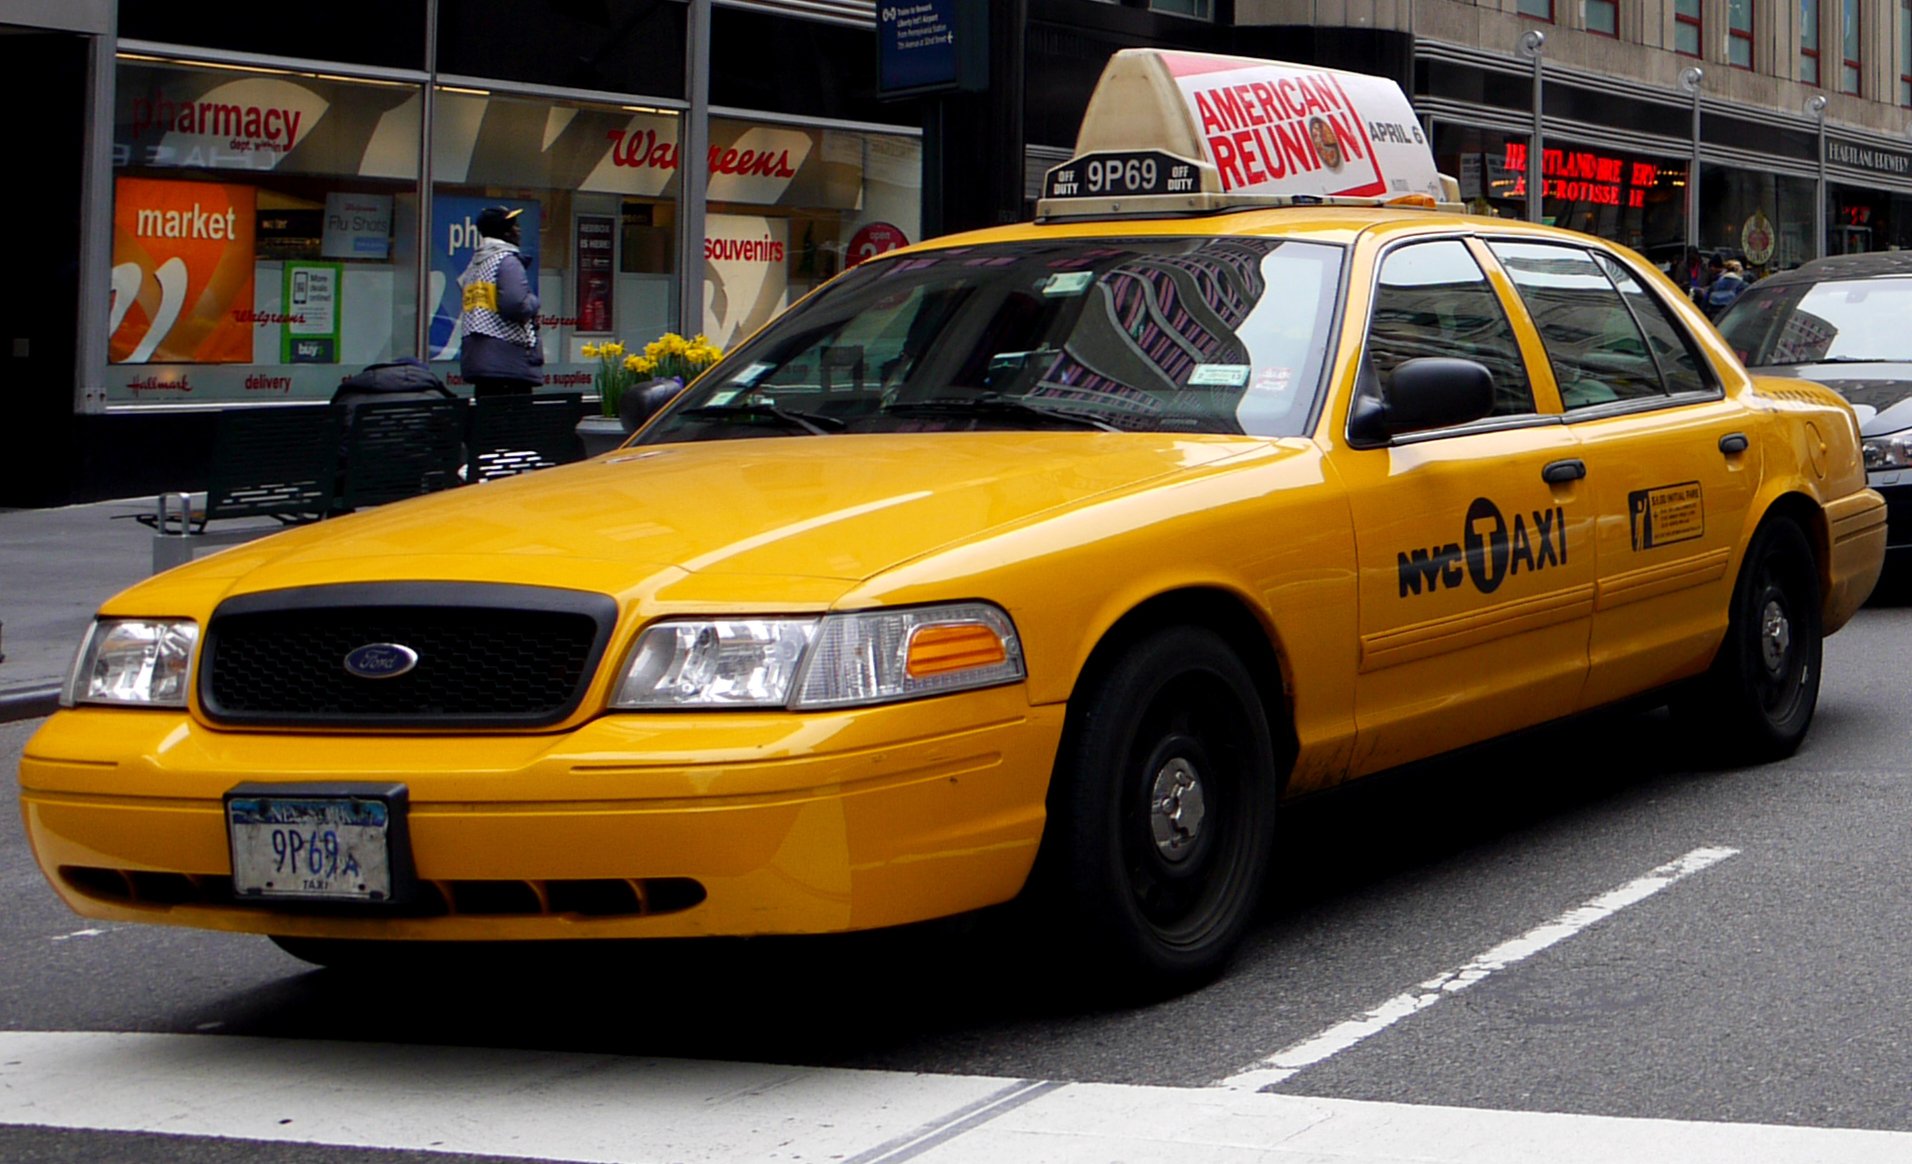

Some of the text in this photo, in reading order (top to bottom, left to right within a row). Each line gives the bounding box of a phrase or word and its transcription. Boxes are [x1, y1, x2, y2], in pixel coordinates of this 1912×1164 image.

[1193, 73, 1343, 136] AMERICAN
[131, 87, 301, 152] pharmacy
[1368, 120, 1424, 144] APRIL 6
[607, 129, 795, 178] Wareens
[1058, 170, 1075, 182] OFF
[1087, 158, 1157, 192] 9P69
[1172, 165, 1189, 178] OFF
[1053, 183, 1079, 195] DUTY
[1167, 178, 1193, 191] DUTY
[1513, 175, 1645, 209] AD ROTISSEIE
[137, 203, 236, 240] market
[328, 215, 388, 233] Flu Shots
[869, 231, 891, 241] open
[704, 234, 784, 262] souvenirs
[233, 309, 306, 327] Walgreens
[126, 374, 192, 396] Hallmark
[244, 374, 291, 393] delivery
[553, 370, 592, 388] supplies
[1397, 500, 1567, 598] NYC TAXI
[359, 649, 397, 670] Ford
[303, 879, 329, 890] TAXI
